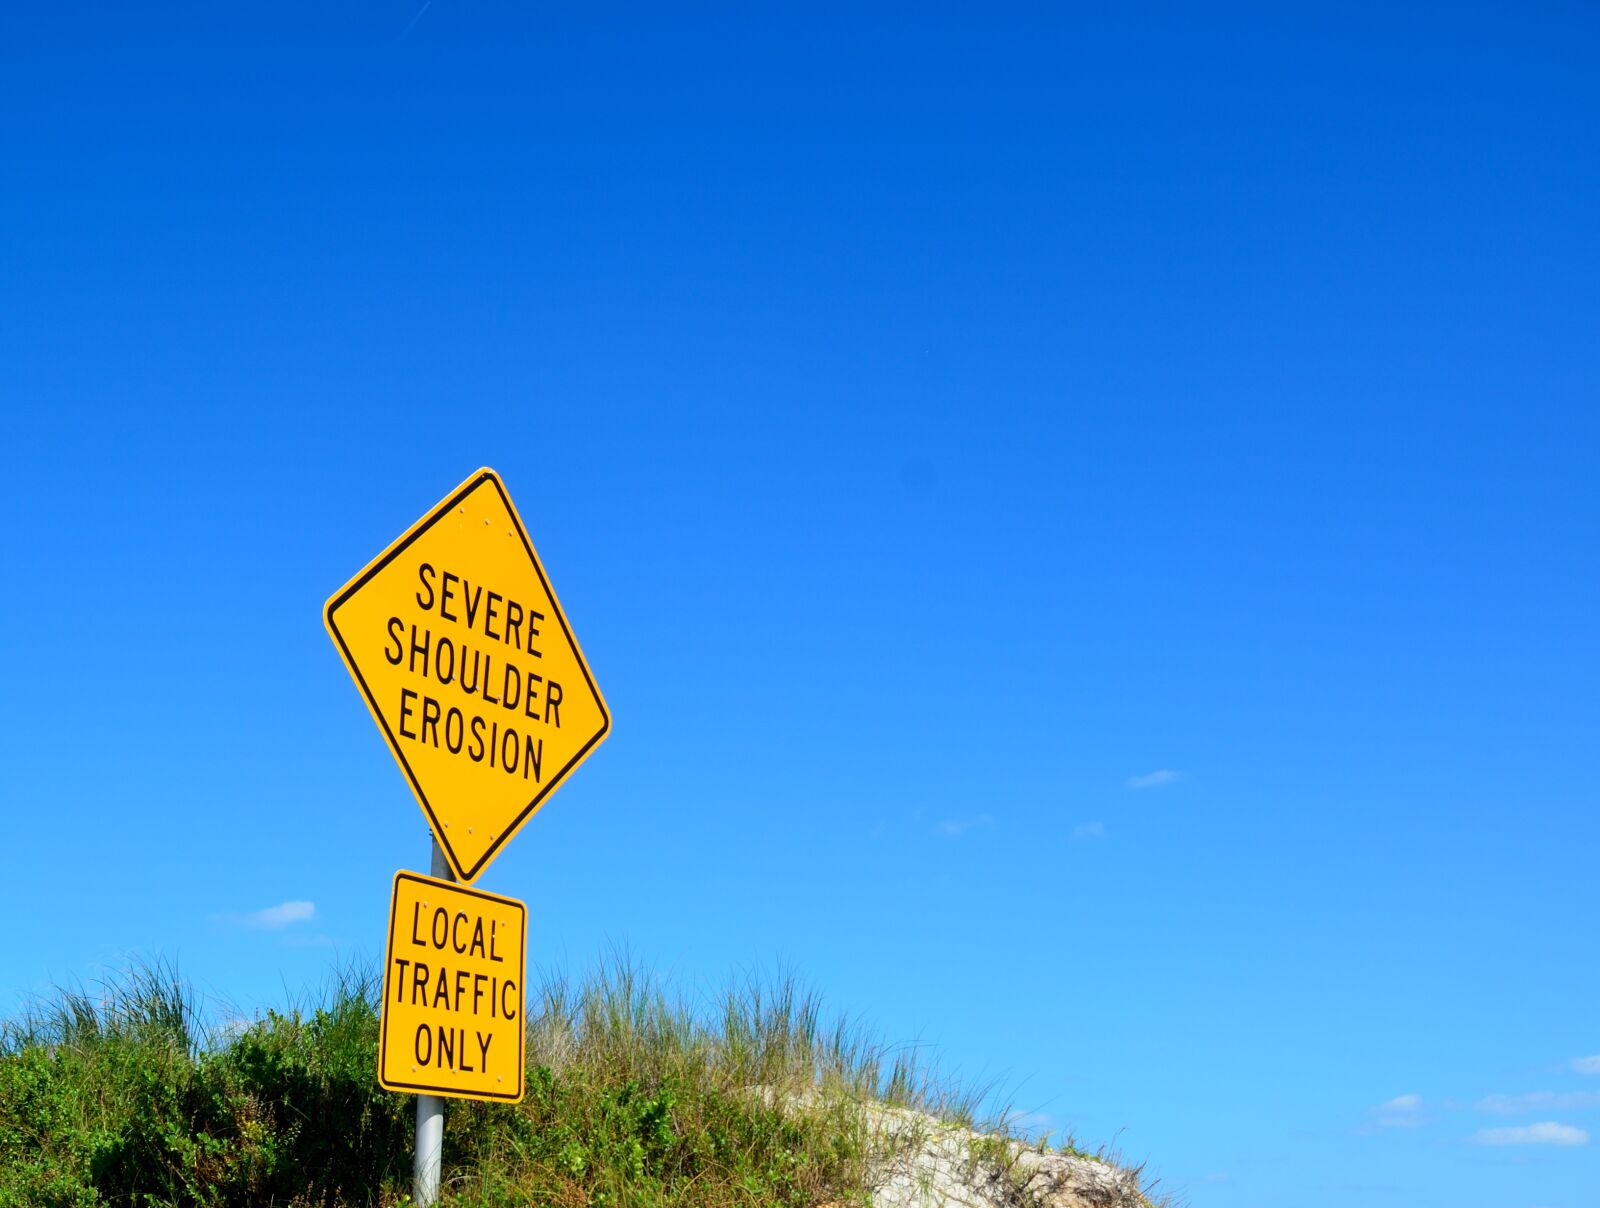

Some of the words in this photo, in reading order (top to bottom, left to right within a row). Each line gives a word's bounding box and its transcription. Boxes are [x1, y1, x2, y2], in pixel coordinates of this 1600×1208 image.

[416, 563, 545, 659] SEVERE
[384, 616, 563, 729] SHOULDER
[399, 688, 543, 784] EROSION
[412, 901, 504, 963] LOCAL
[395, 958, 517, 1020] TRAFFIC
[414, 1023, 493, 1074] ONLY
